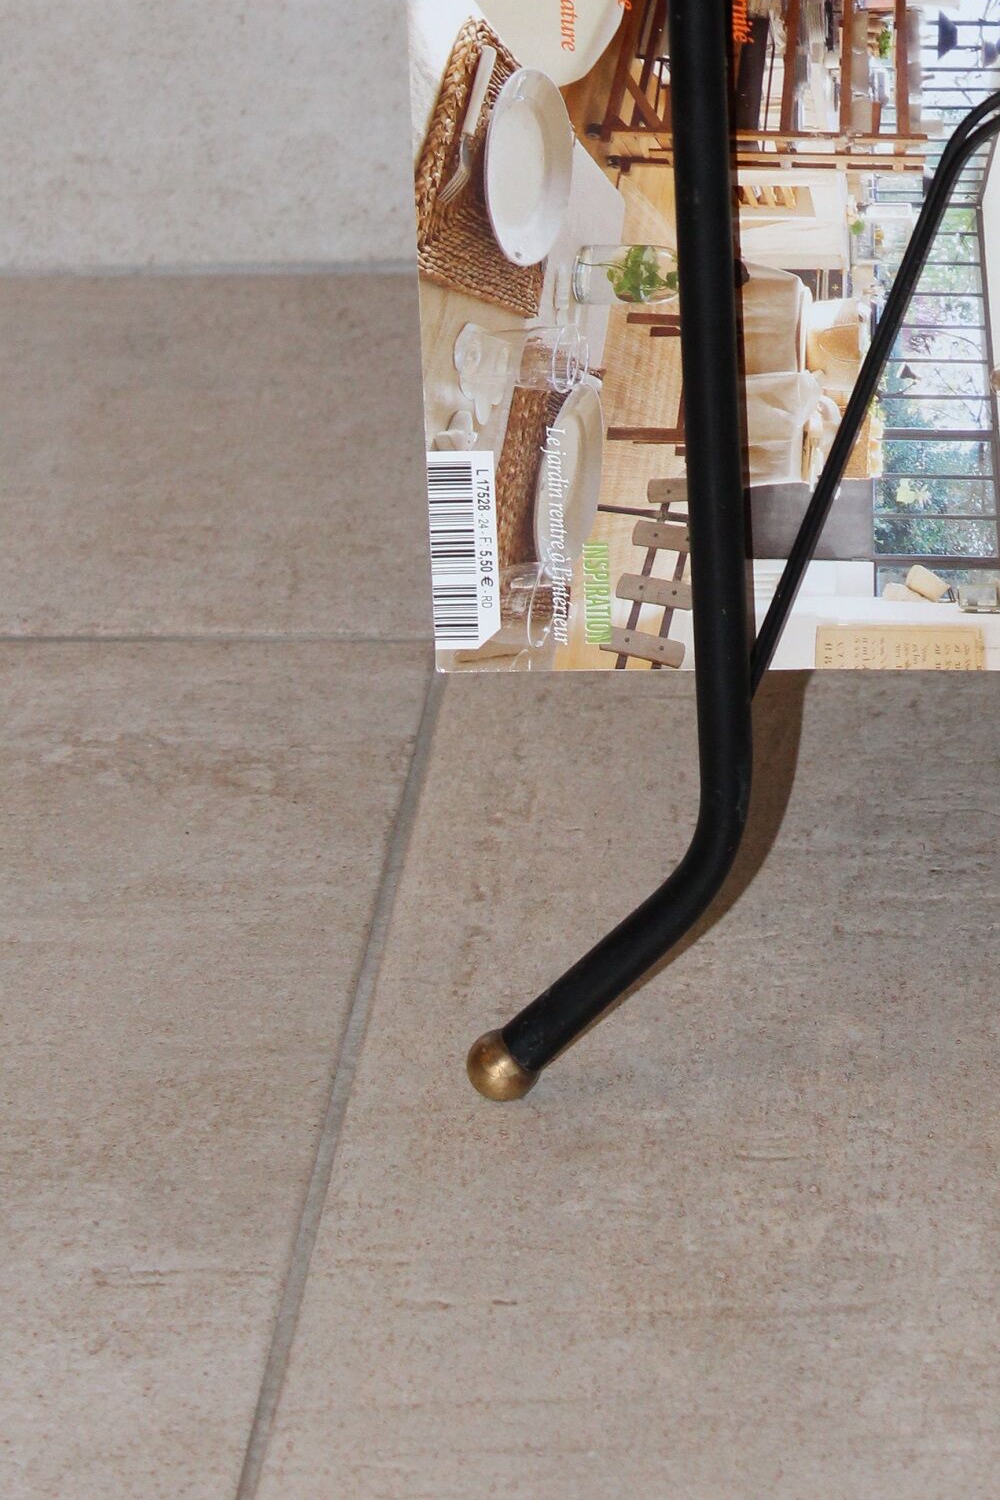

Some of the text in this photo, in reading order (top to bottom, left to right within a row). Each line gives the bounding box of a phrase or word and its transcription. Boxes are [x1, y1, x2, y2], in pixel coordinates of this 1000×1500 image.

[477, 479, 490, 511] 17528
[478, 518, 489, 529] 24
[540, 425, 573, 646] Le jardin rentre à l'intérieur
[478, 550, 492, 572] 5,50
[481, 576, 494, 587] €
[481, 595, 493, 609] RD
[582, 542, 612, 645] INSPIRATION
